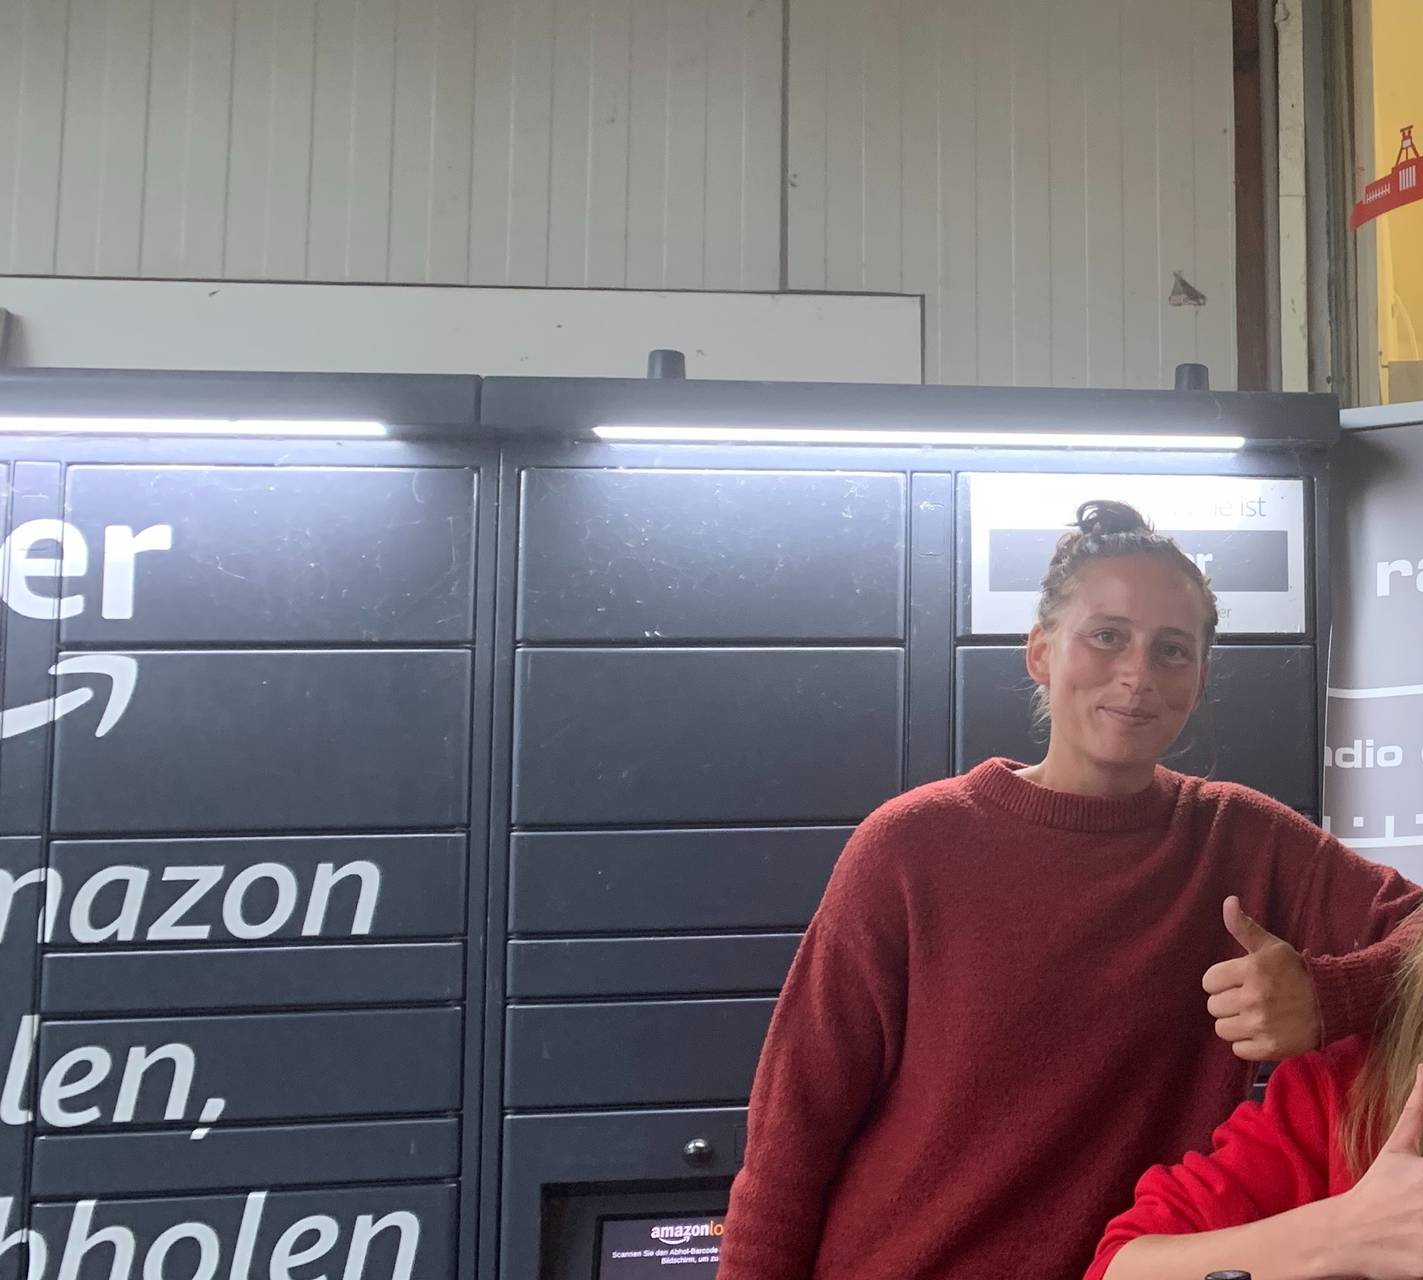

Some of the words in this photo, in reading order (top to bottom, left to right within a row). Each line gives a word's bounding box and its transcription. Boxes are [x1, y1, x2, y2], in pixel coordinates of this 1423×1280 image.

[1240, 496, 1267, 518] ist
[0, 518, 173, 620] er
[1324, 739, 1403, 769] dio
[0, 1014, 226, 1140] len,
[650, 1220, 724, 1239] amazonlo
